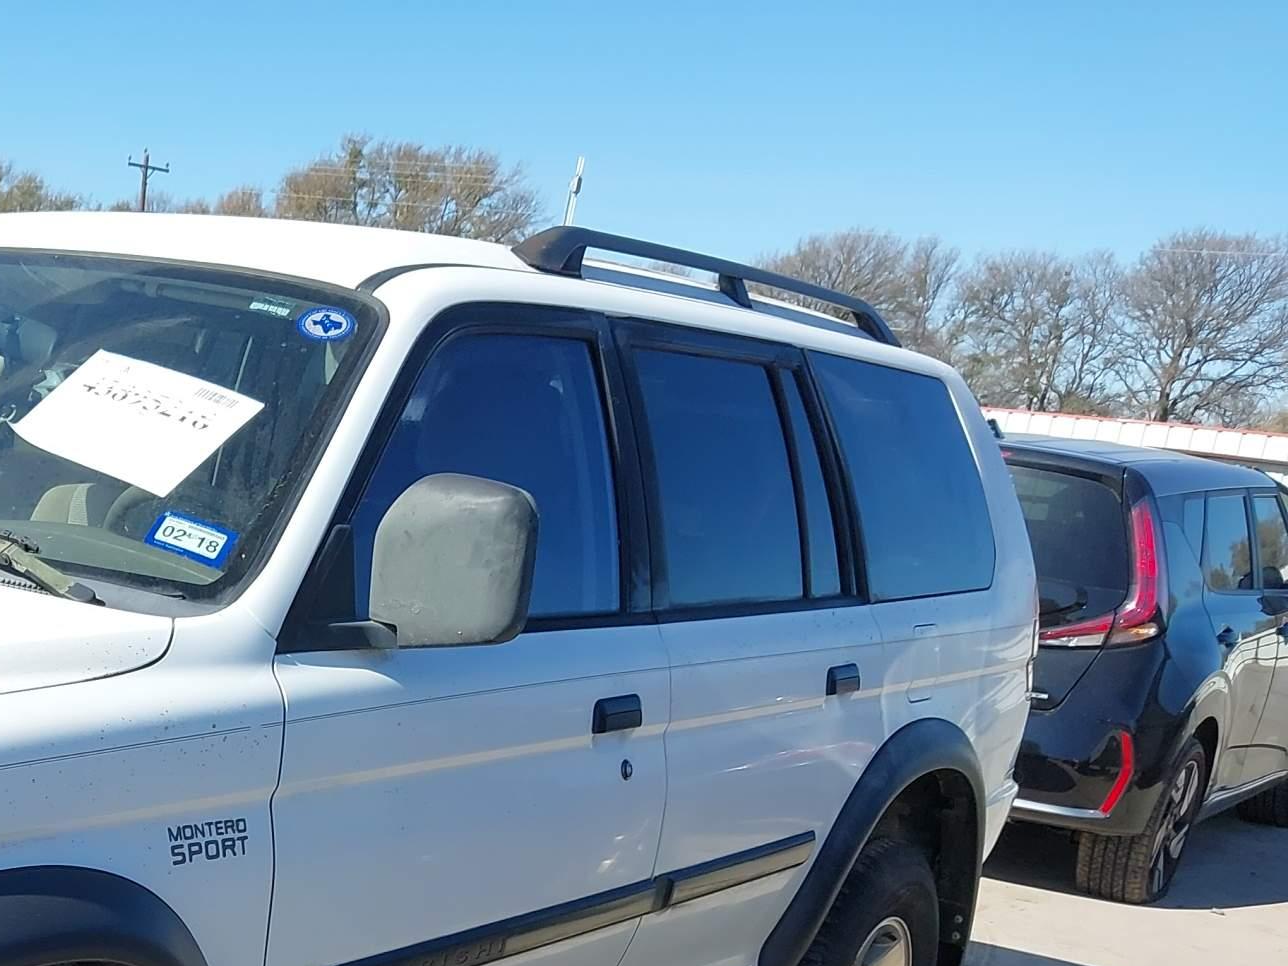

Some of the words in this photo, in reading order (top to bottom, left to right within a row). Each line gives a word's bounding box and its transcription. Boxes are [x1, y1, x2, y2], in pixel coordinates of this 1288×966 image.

[162, 525, 187, 542] 02
[197, 537, 220, 553] 18
[168, 818, 247, 842] MONTERO
[171, 836, 248, 866] SPORT
